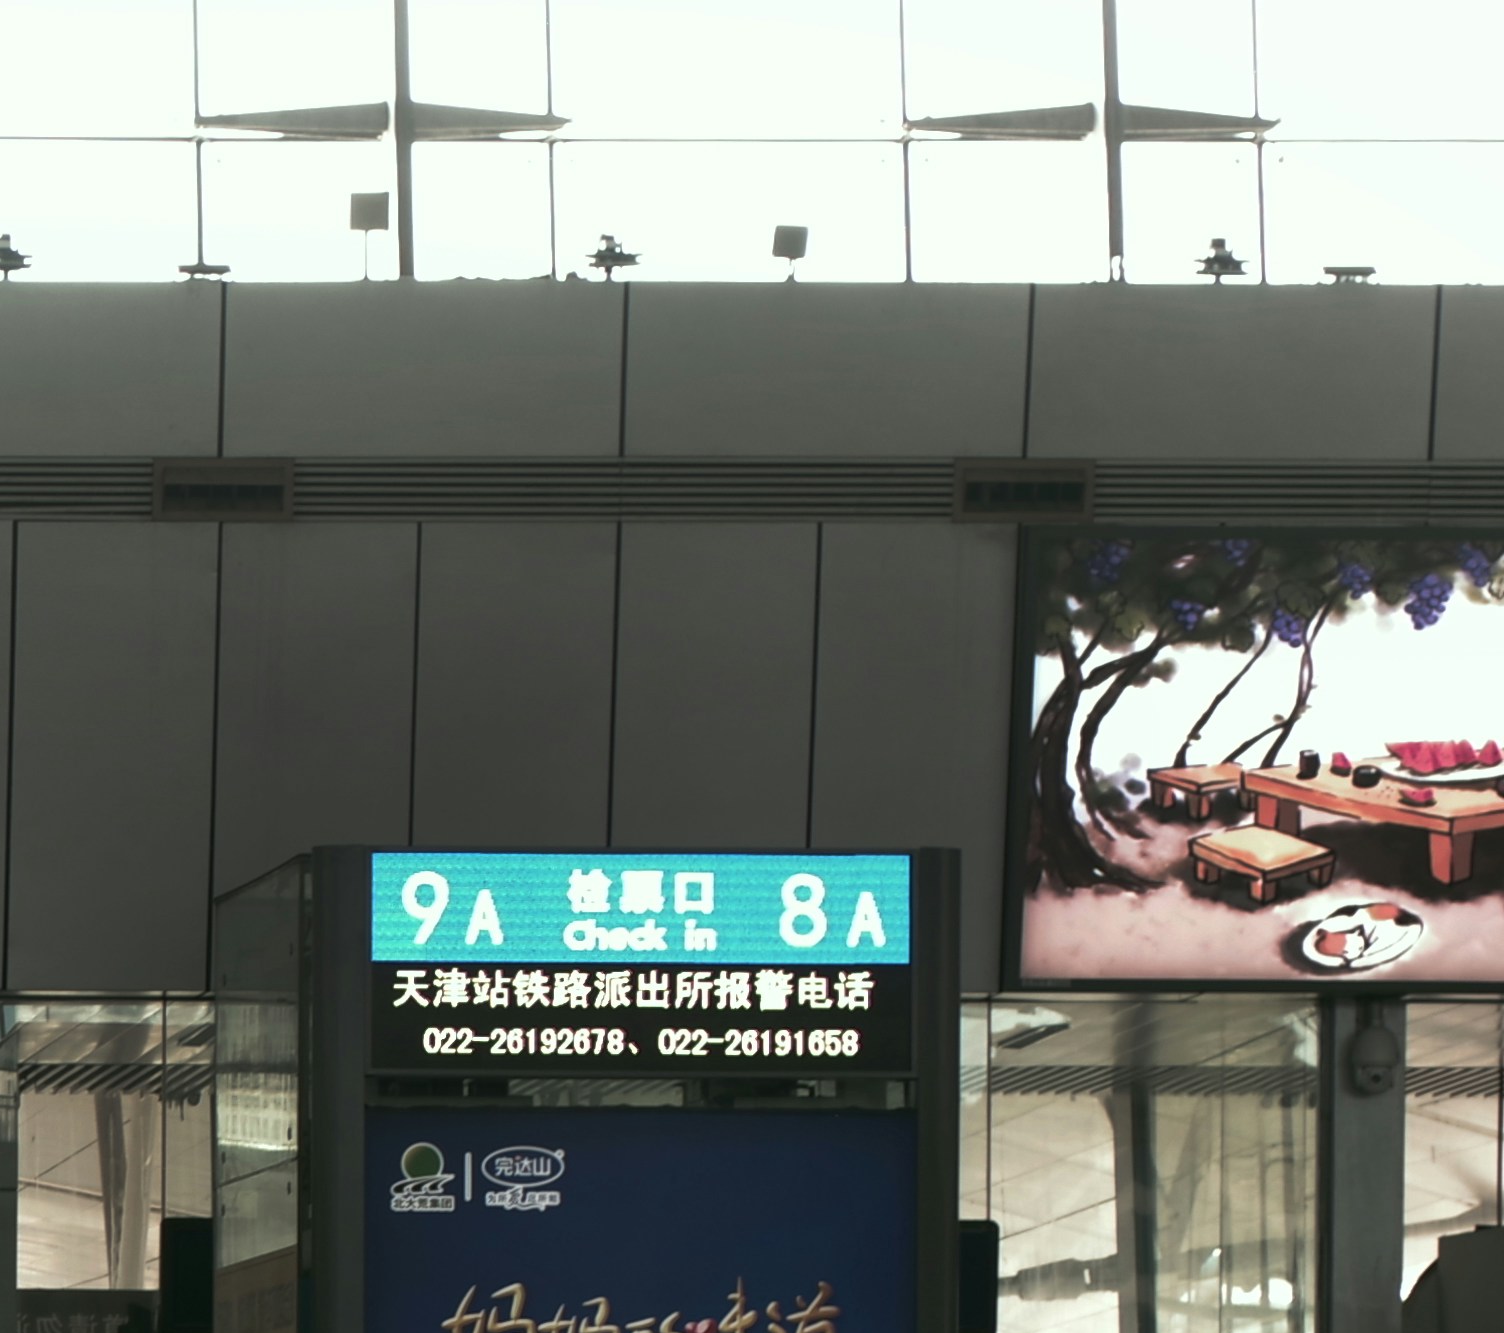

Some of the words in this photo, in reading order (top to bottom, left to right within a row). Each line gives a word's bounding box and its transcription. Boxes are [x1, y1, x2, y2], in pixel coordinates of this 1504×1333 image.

[400, 870, 505, 946] 9A
[566, 869, 716, 915] 检票口
[779, 873, 887, 949] 8A
[563, 919, 669, 952] Check
[684, 921, 718, 952] in
[392, 968, 875, 1011] 天津站铁路派出所报警电话
[494, 1156, 552, 1177] 完达山
